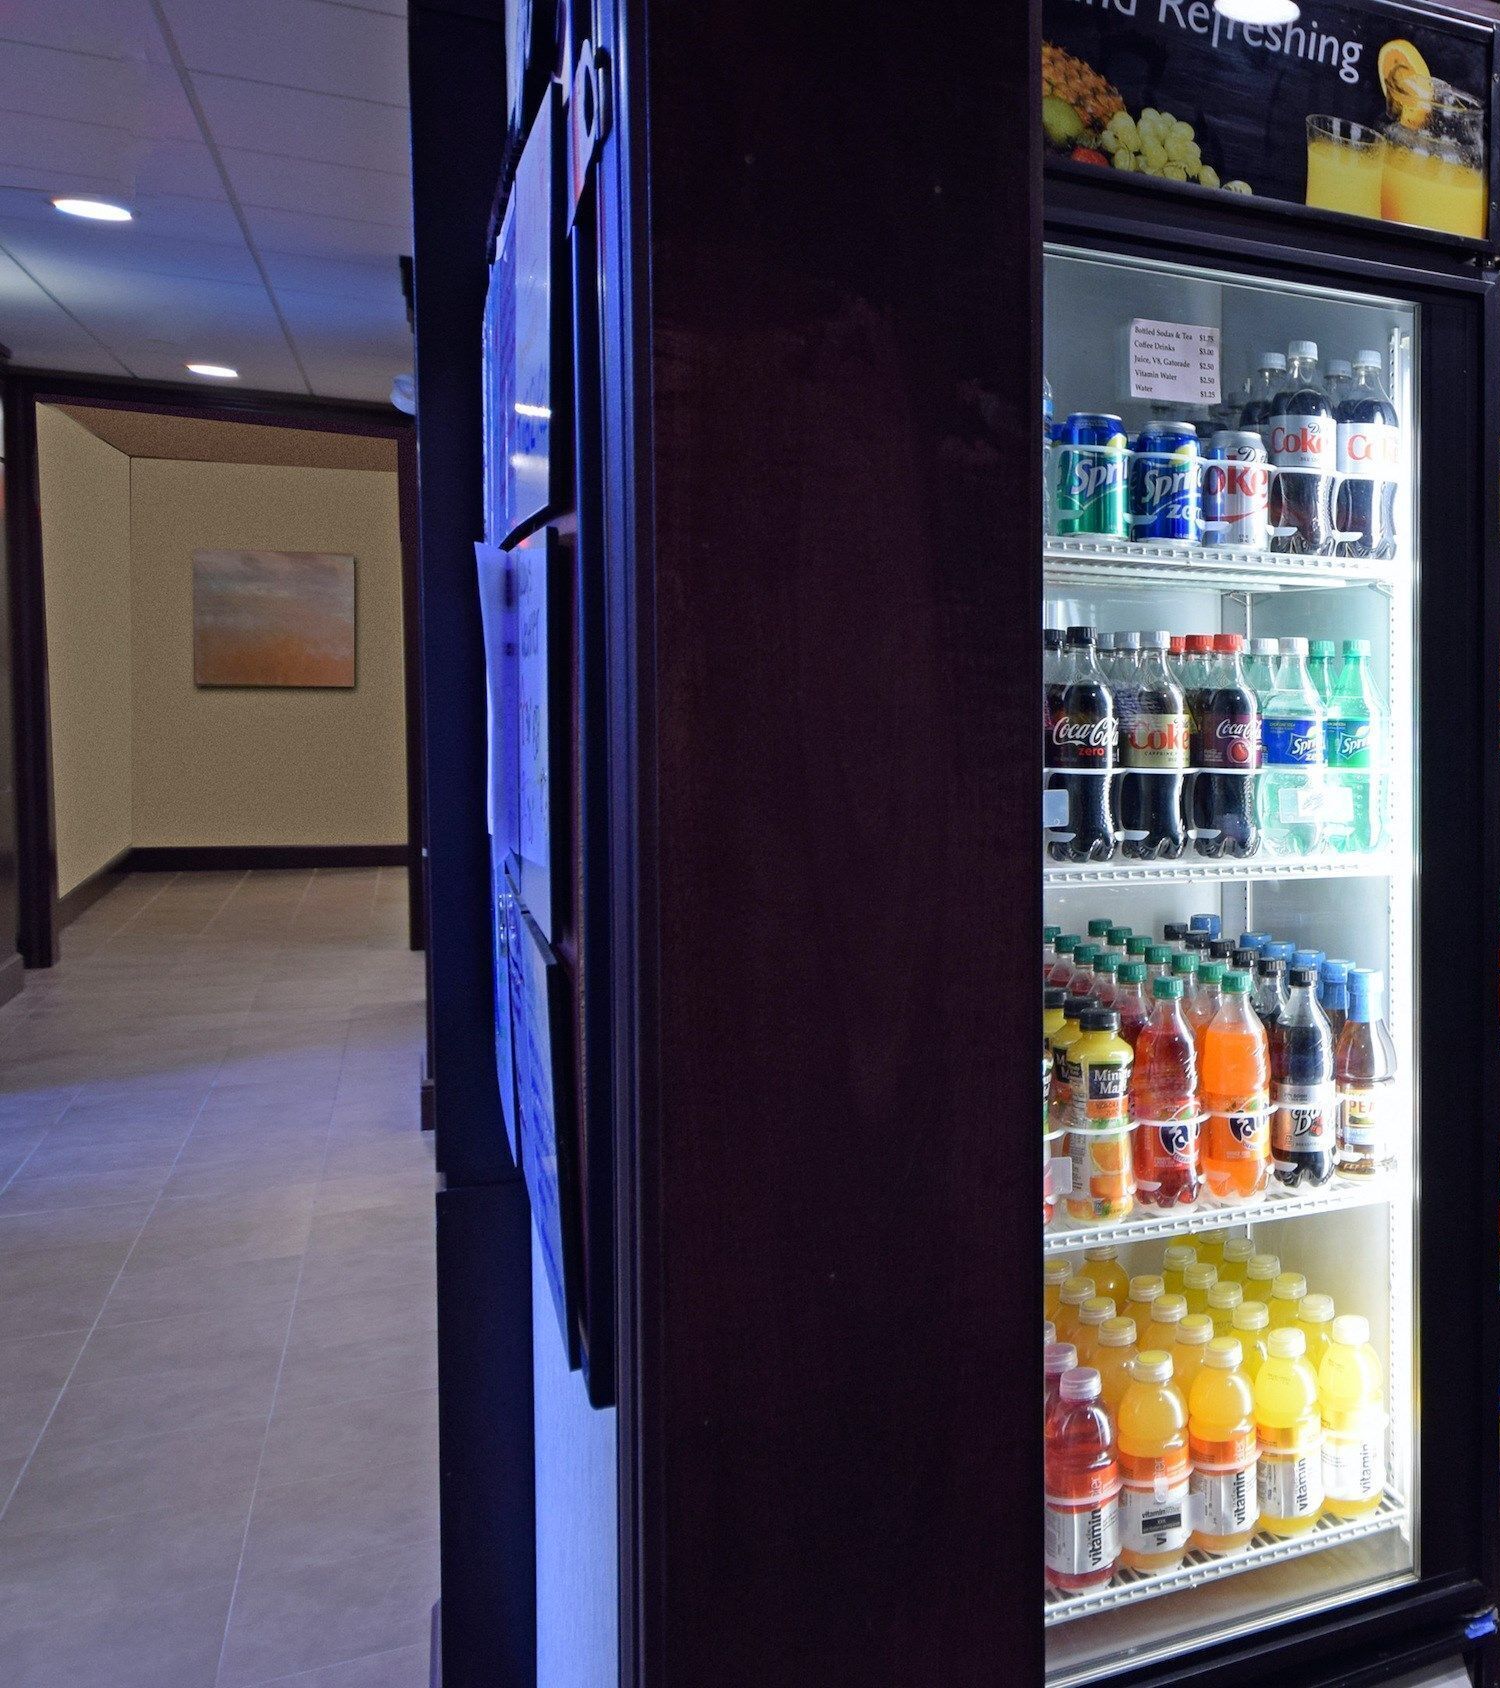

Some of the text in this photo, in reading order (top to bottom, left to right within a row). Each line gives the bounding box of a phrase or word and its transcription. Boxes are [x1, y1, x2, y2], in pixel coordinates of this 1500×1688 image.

[1134, 326, 1155, 336] Bottled
[1156, 330, 1174, 338] Sodas
[1134, 340, 1153, 349] Coffee
[1154, 343, 1175, 352] Drinks
[1163, 358, 1190, 368] Gatorade
[1135, 370, 1159, 379] Vitamin
[1160, 372, 1177, 381] Water
[1135, 384, 1153, 393] Water
[1271, 426, 1328, 454] Cok
[1203, 454, 1268, 498] oke
[1078, 746, 1104, 756] zero
[1296, 1457, 1308, 1512] vitamin
[1232, 1470, 1245, 1526] vitamin
[1089, 1508, 1102, 1566] vitamin
